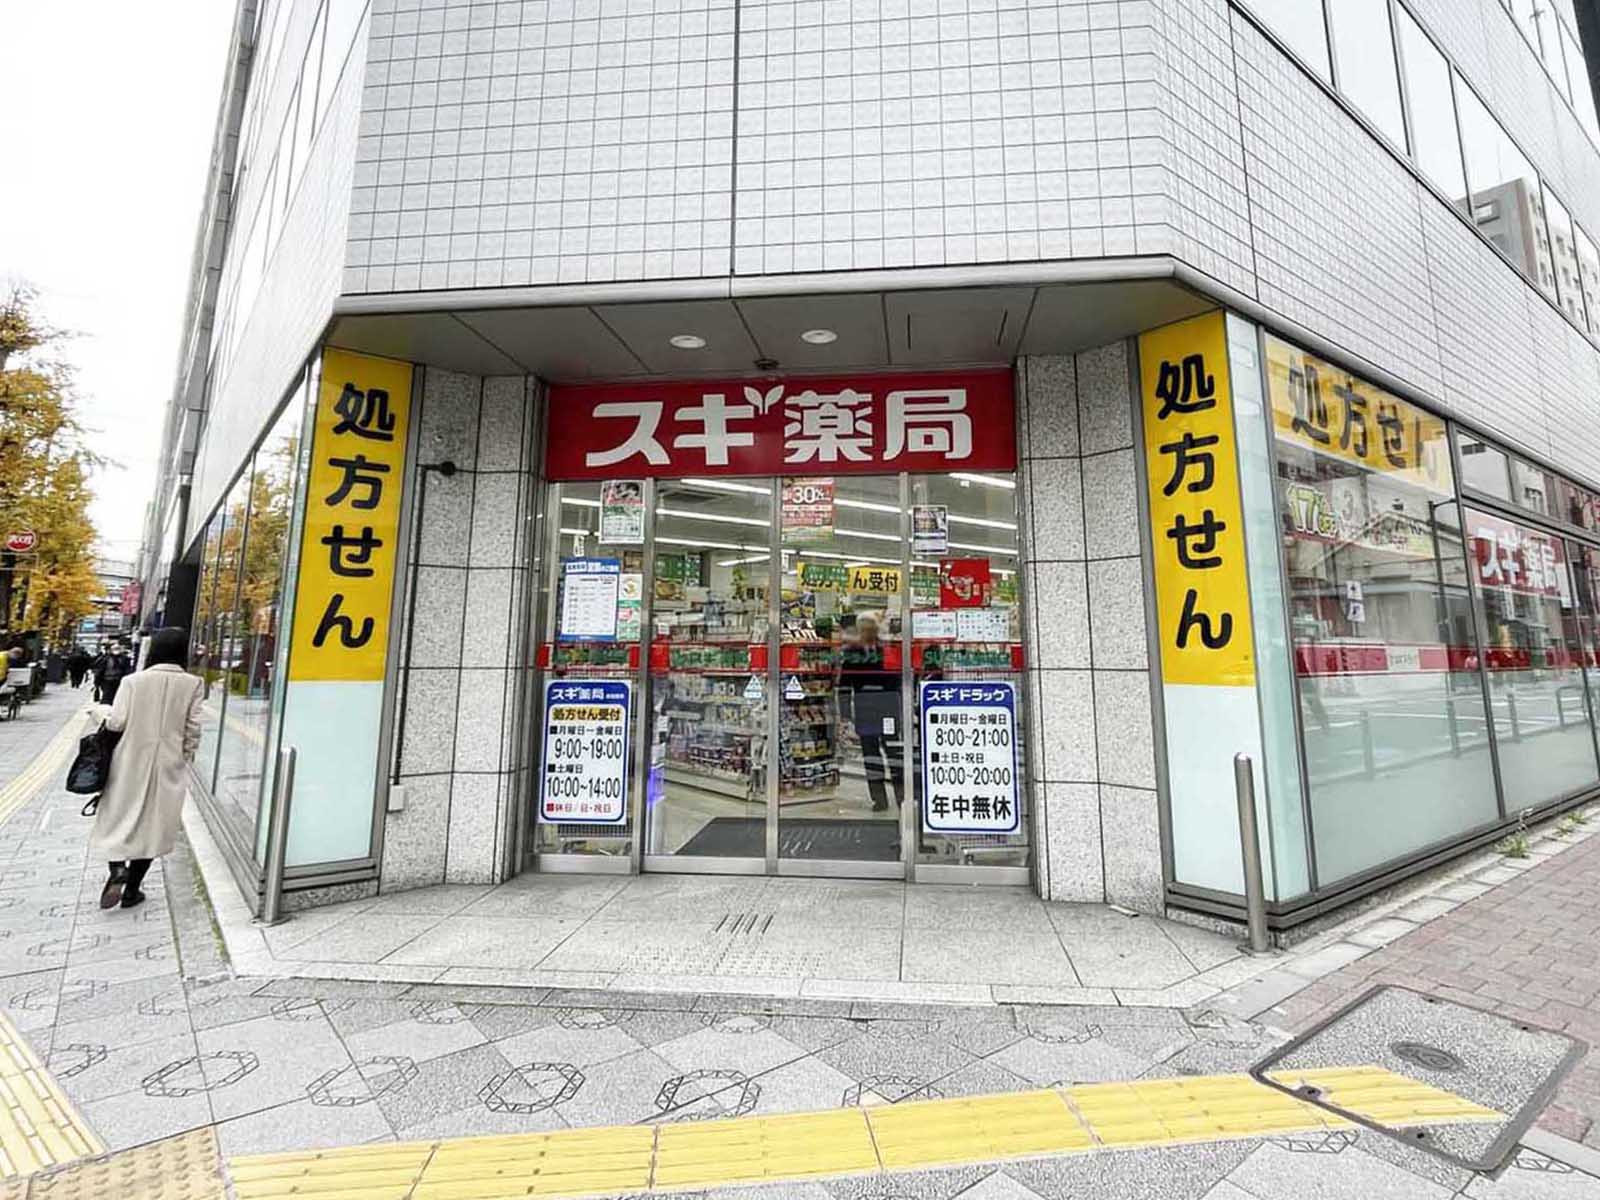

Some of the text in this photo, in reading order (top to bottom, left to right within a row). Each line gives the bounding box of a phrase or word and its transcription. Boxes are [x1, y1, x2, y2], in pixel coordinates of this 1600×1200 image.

[586, 385, 972, 467] スギ薬局
[312, 382, 396, 648] 処方せん
[1156, 353, 1232, 649] 処方せん
[552, 708, 620, 721] 処方せん受付
[931, 794, 1012, 821] 年中無休
